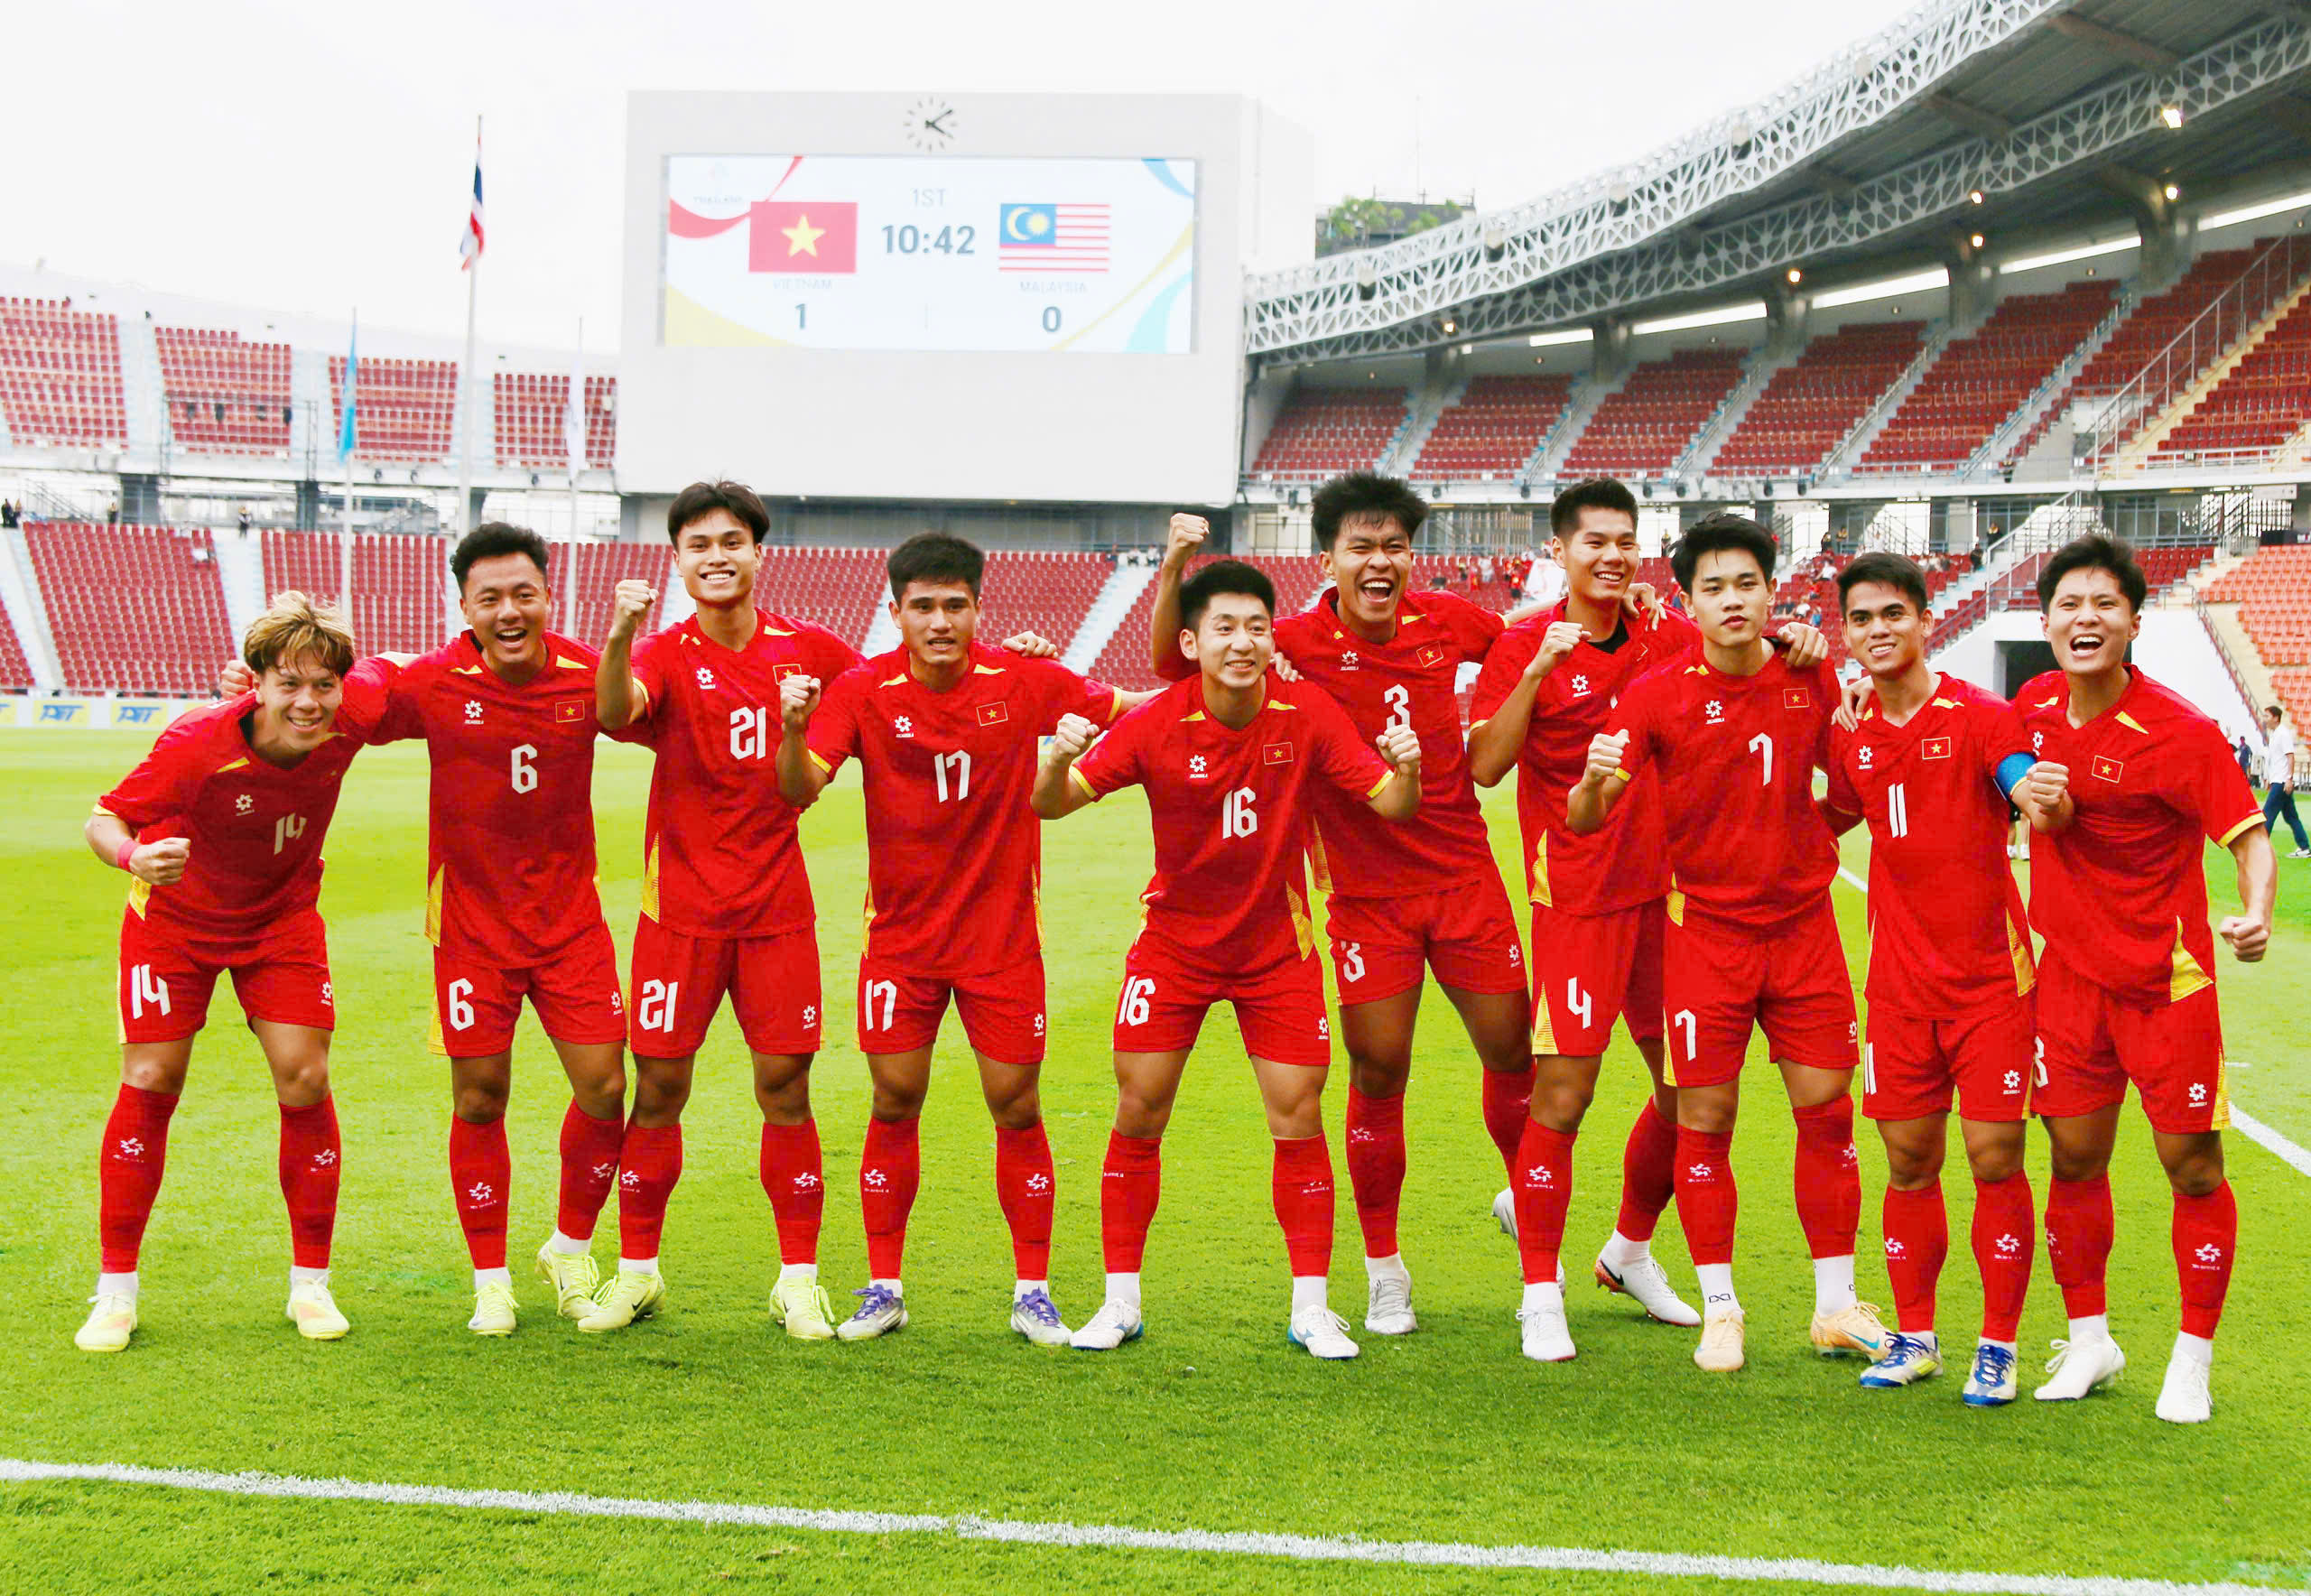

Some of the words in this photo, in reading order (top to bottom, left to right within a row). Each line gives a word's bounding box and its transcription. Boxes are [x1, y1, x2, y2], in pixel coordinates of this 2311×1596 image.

[912, 187, 947, 207] 1ST
[882, 224, 977, 255] 10:42
[772, 277, 833, 290] VIETNAM
[1019, 280, 1088, 293] MALAYSIA
[794, 302, 806, 329] 1
[1042, 305, 1063, 333] 0
[1384, 683, 1410, 729] 3
[729, 707, 766, 760] 21
[1749, 732, 1772, 786] 7
[511, 743, 538, 794] 6
[933, 749, 970, 803] 17
[274, 812, 307, 855] 14
[1221, 786, 1258, 840] 16
[1888, 783, 1908, 839] 11
[1341, 941, 1365, 983] 3
[131, 963, 171, 1020] 14
[449, 978, 475, 1031] 6
[639, 979, 679, 1034] 21
[865, 979, 897, 1032] 17
[1118, 976, 1156, 1026] 16
[1568, 977, 1592, 1030] 4
[1675, 1008, 1696, 1062] 7
